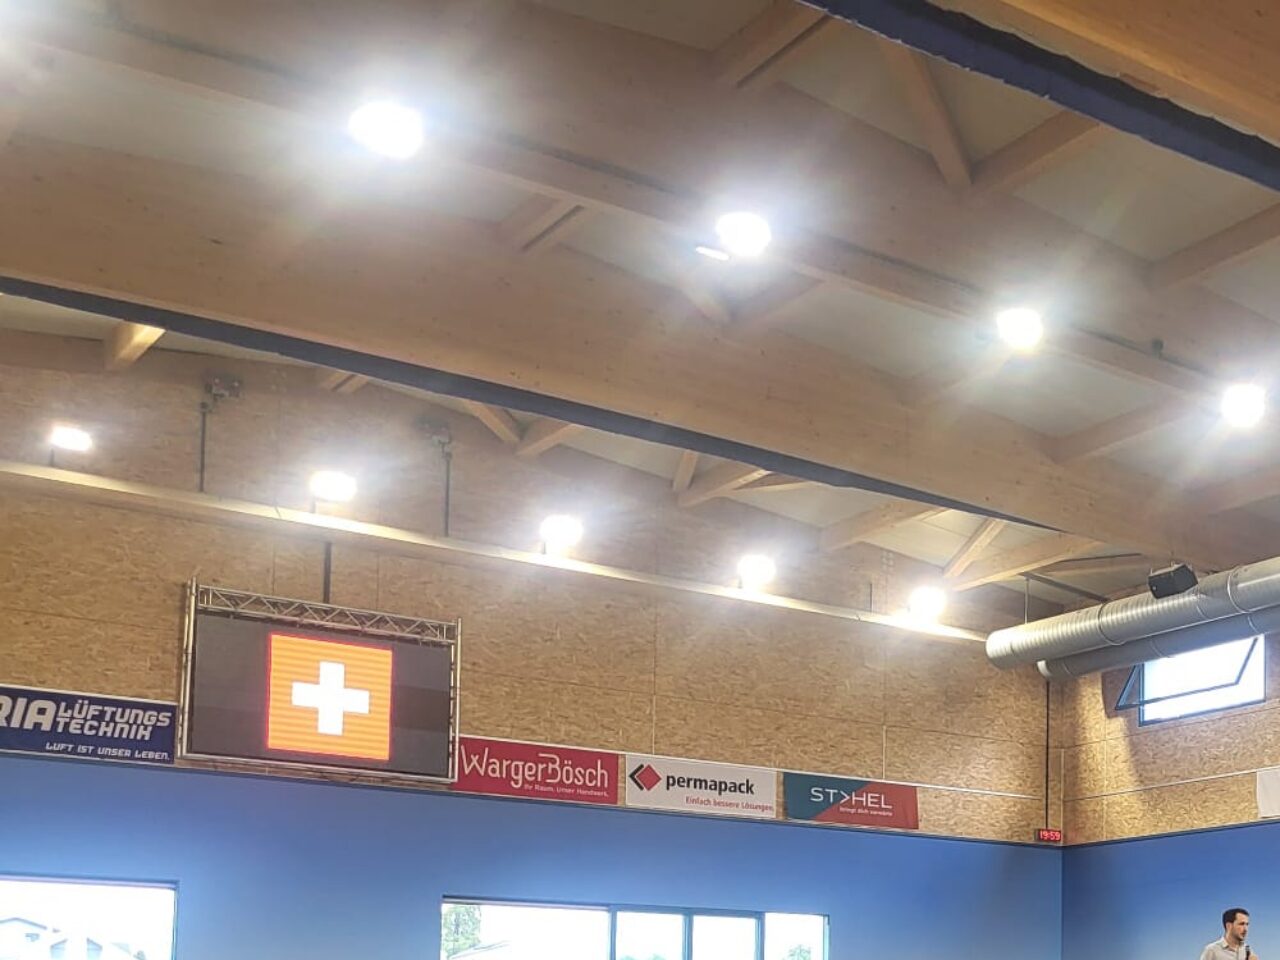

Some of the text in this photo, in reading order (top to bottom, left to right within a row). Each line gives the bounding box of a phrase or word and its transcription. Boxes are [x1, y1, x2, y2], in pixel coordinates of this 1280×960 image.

[57, 700, 172, 727] LÜFTUNGS
[56, 717, 152, 741] TECHNIK
[45, 742, 74, 752] LUFT
[77, 745, 95, 754] IST
[97, 747, 131, 757] UNSER
[666, 774, 755, 796] permapack
[685, 796, 711, 806] Einfach
